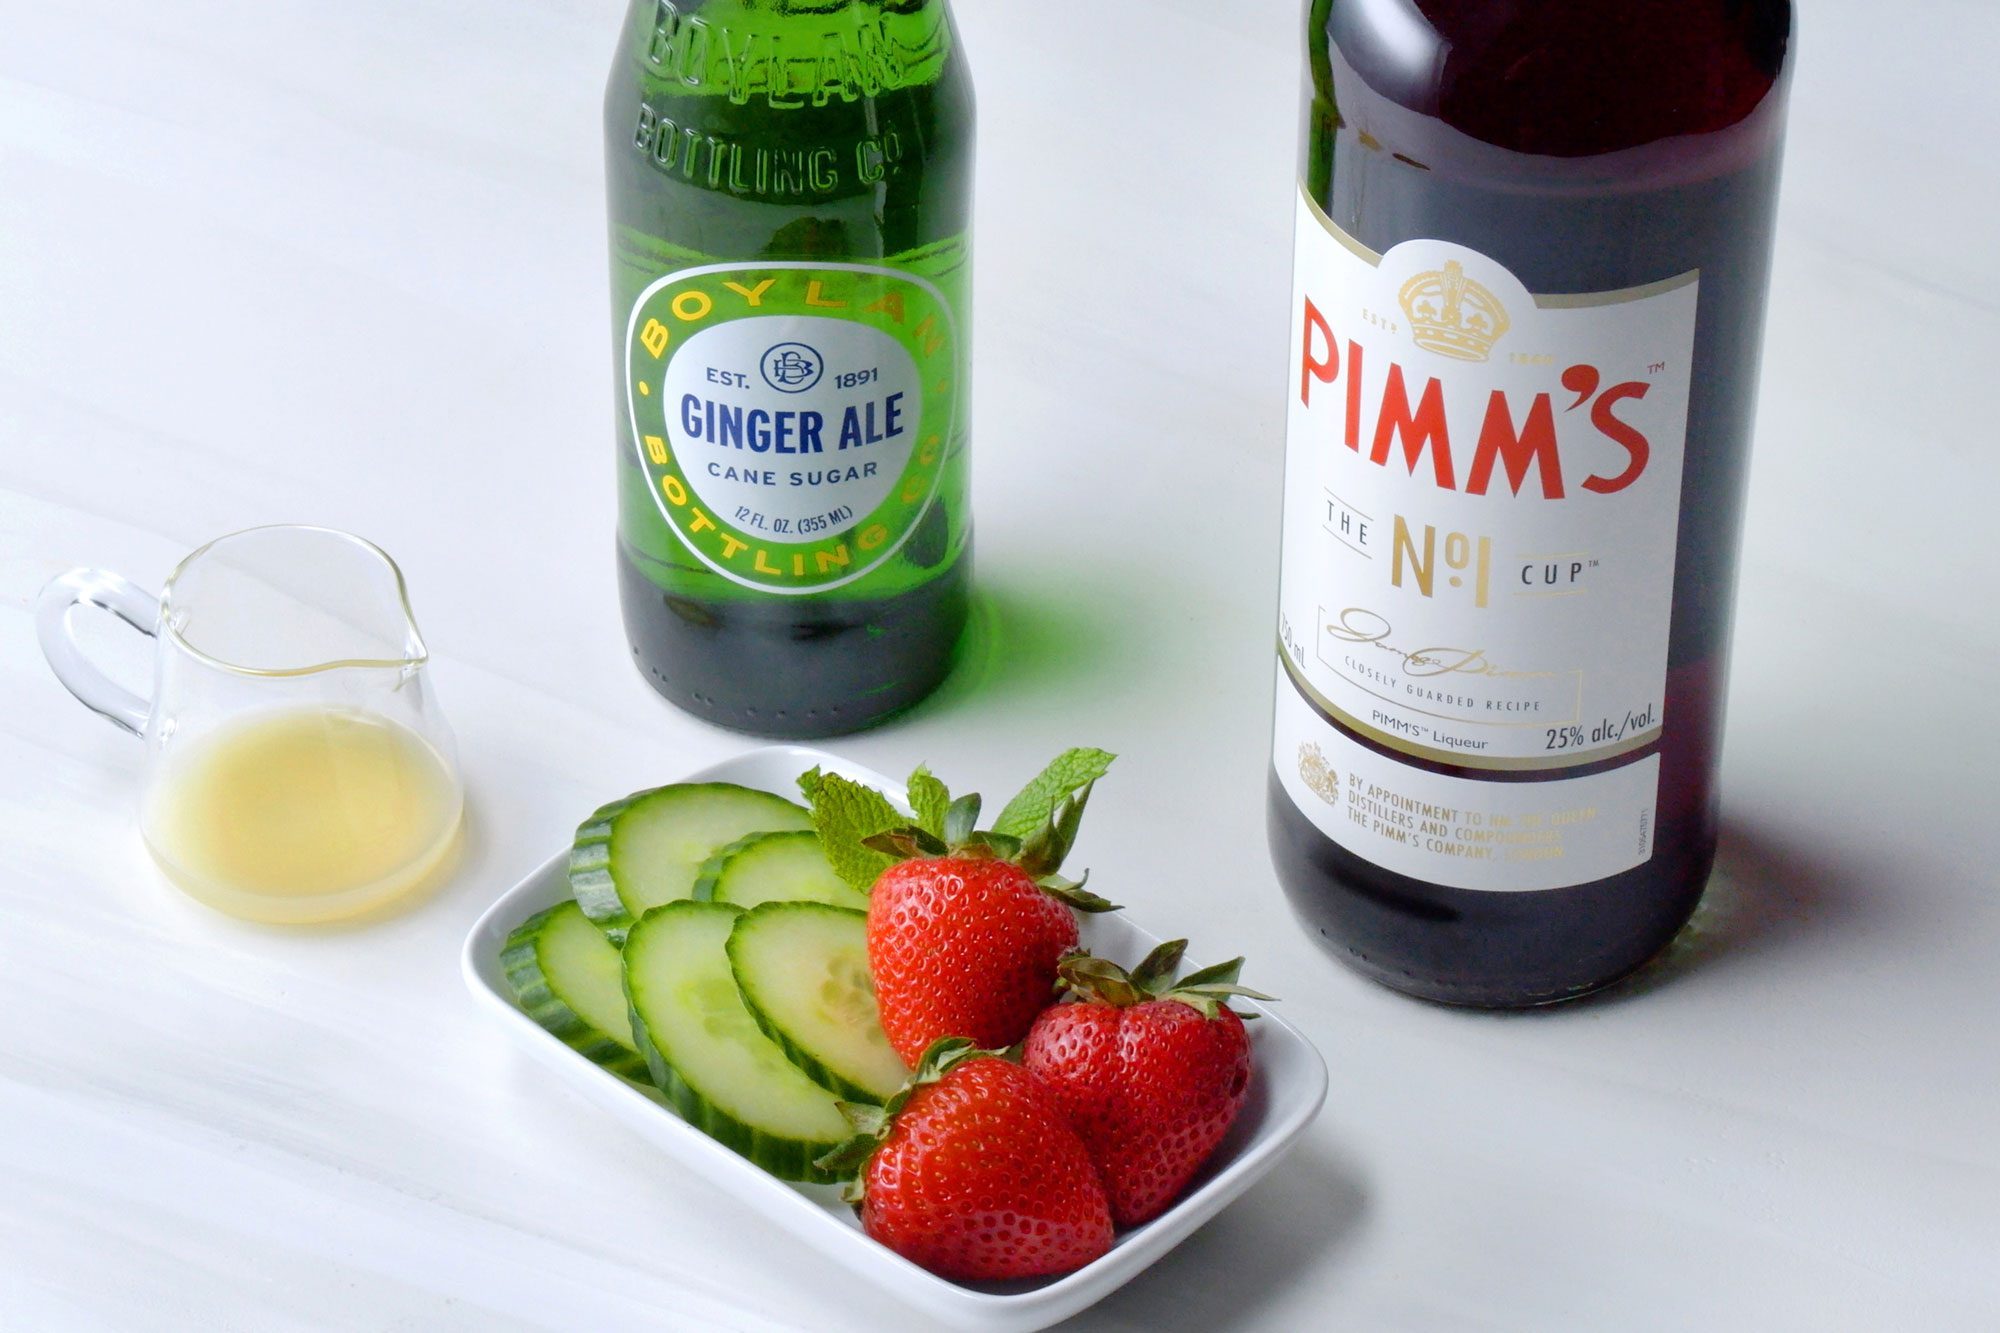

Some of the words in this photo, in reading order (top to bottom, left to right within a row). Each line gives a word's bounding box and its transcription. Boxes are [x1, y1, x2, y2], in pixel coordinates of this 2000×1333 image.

[633, 102, 838, 194] BOTTLING
[640, 279, 945, 360] BOYLAN
[706, 366, 751, 389] EST.
[834, 367, 879, 389] 1891
[1301, 293, 1651, 500] PIMM'S
[681, 393, 824, 454] GINGER
[838, 391, 904, 450] ALE
[707, 462, 777, 486] CANE
[789, 462, 879, 486] SUGAR
[645, 435, 888, 577] BOTTLING
[734, 505, 750, 522] 12
[750, 513, 768, 531] FL.
[773, 518, 793, 533] OZ.
[797, 515, 827, 535] (355
[828, 505, 853, 526] ML)
[1327, 500, 1369, 546] THE
[1521, 562, 1582, 585] CUP
[1345, 656, 1397, 688] CLOSELY
[1406, 684, 1474, 708] GUARDED
[1486, 700, 1541, 711] RECIPE
[1433, 730, 1488, 750] Liqueur
[1546, 724, 1584, 750] 25%
[1592, 703, 1656, 741] alc./vol.
[1348, 790, 1414, 829] DISTILLERS
[1420, 820, 1448, 837] AND
[1349, 773, 1363, 790] BY
[1367, 784, 1459, 823] APPOINTMENT
[1465, 812, 1481, 826] TO
[1347, 806, 1368, 828] THE
[1373, 820, 1419, 848] PIMM'S
